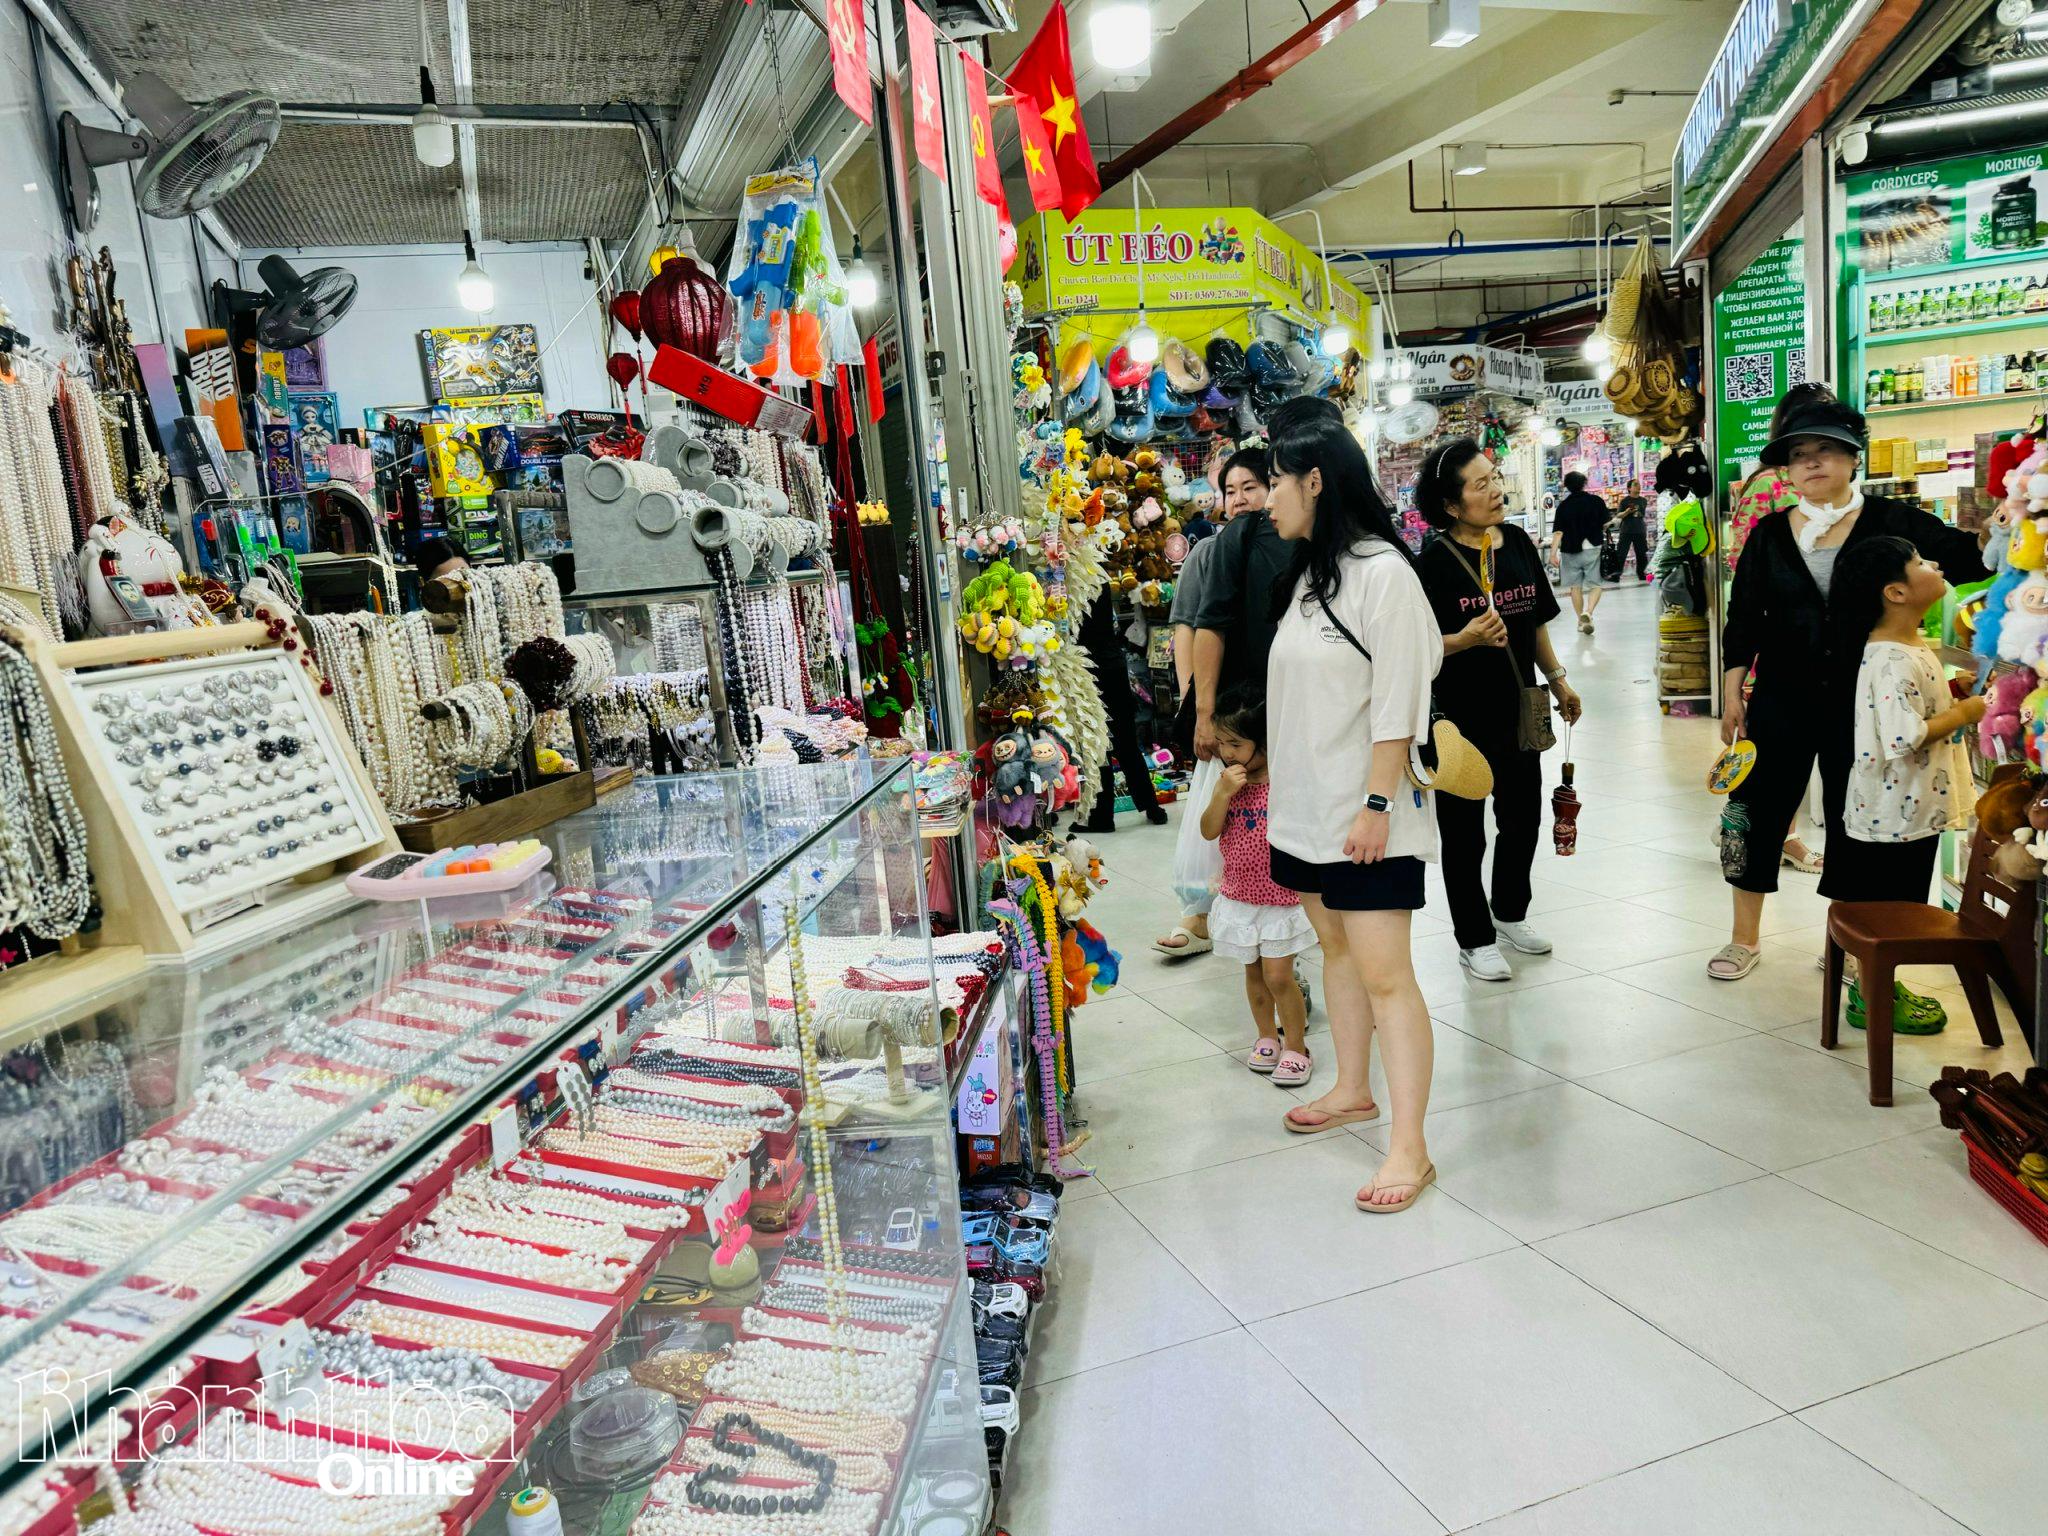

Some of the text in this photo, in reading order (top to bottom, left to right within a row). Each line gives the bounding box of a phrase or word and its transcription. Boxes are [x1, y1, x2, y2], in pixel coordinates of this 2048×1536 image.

[1683, 53, 1726, 187] PHARMACY
[1985, 154, 2043, 174] MORINGA
[1871, 170, 1939, 192] CORDYCEPS
[1062, 223, 1194, 266] ÚT BÉO
[1737, 275, 1786, 288] ПРЕПАРАТЫ
[1195, 289, 1249, 299] 0369.276.206
[1725, 283, 1803, 302] ЛИЦЕНЗИРОВАННЫХ
[1723, 303, 1750, 314] ЧТОБЫ
[1751, 297, 1792, 310] ИЗБЕЖАТЬ
[1730, 315, 1765, 327] ЖЕЛАЕМ
[1767, 312, 1785, 323] ВАМ
[1724, 331, 1730, 340] И
[1732, 322, 1793, 339] ЕСТЕСТВЕННОЙ
[1735, 339, 1786, 352] ПРИНИМАЕМ
[1407, 350, 1448, 369] Ngân
[209, 346, 236, 401] AUTO
[1544, 383, 1602, 406] Ngân
[521, 457, 547, 465] DOUBLE
[469, 532, 488, 540] DINO
